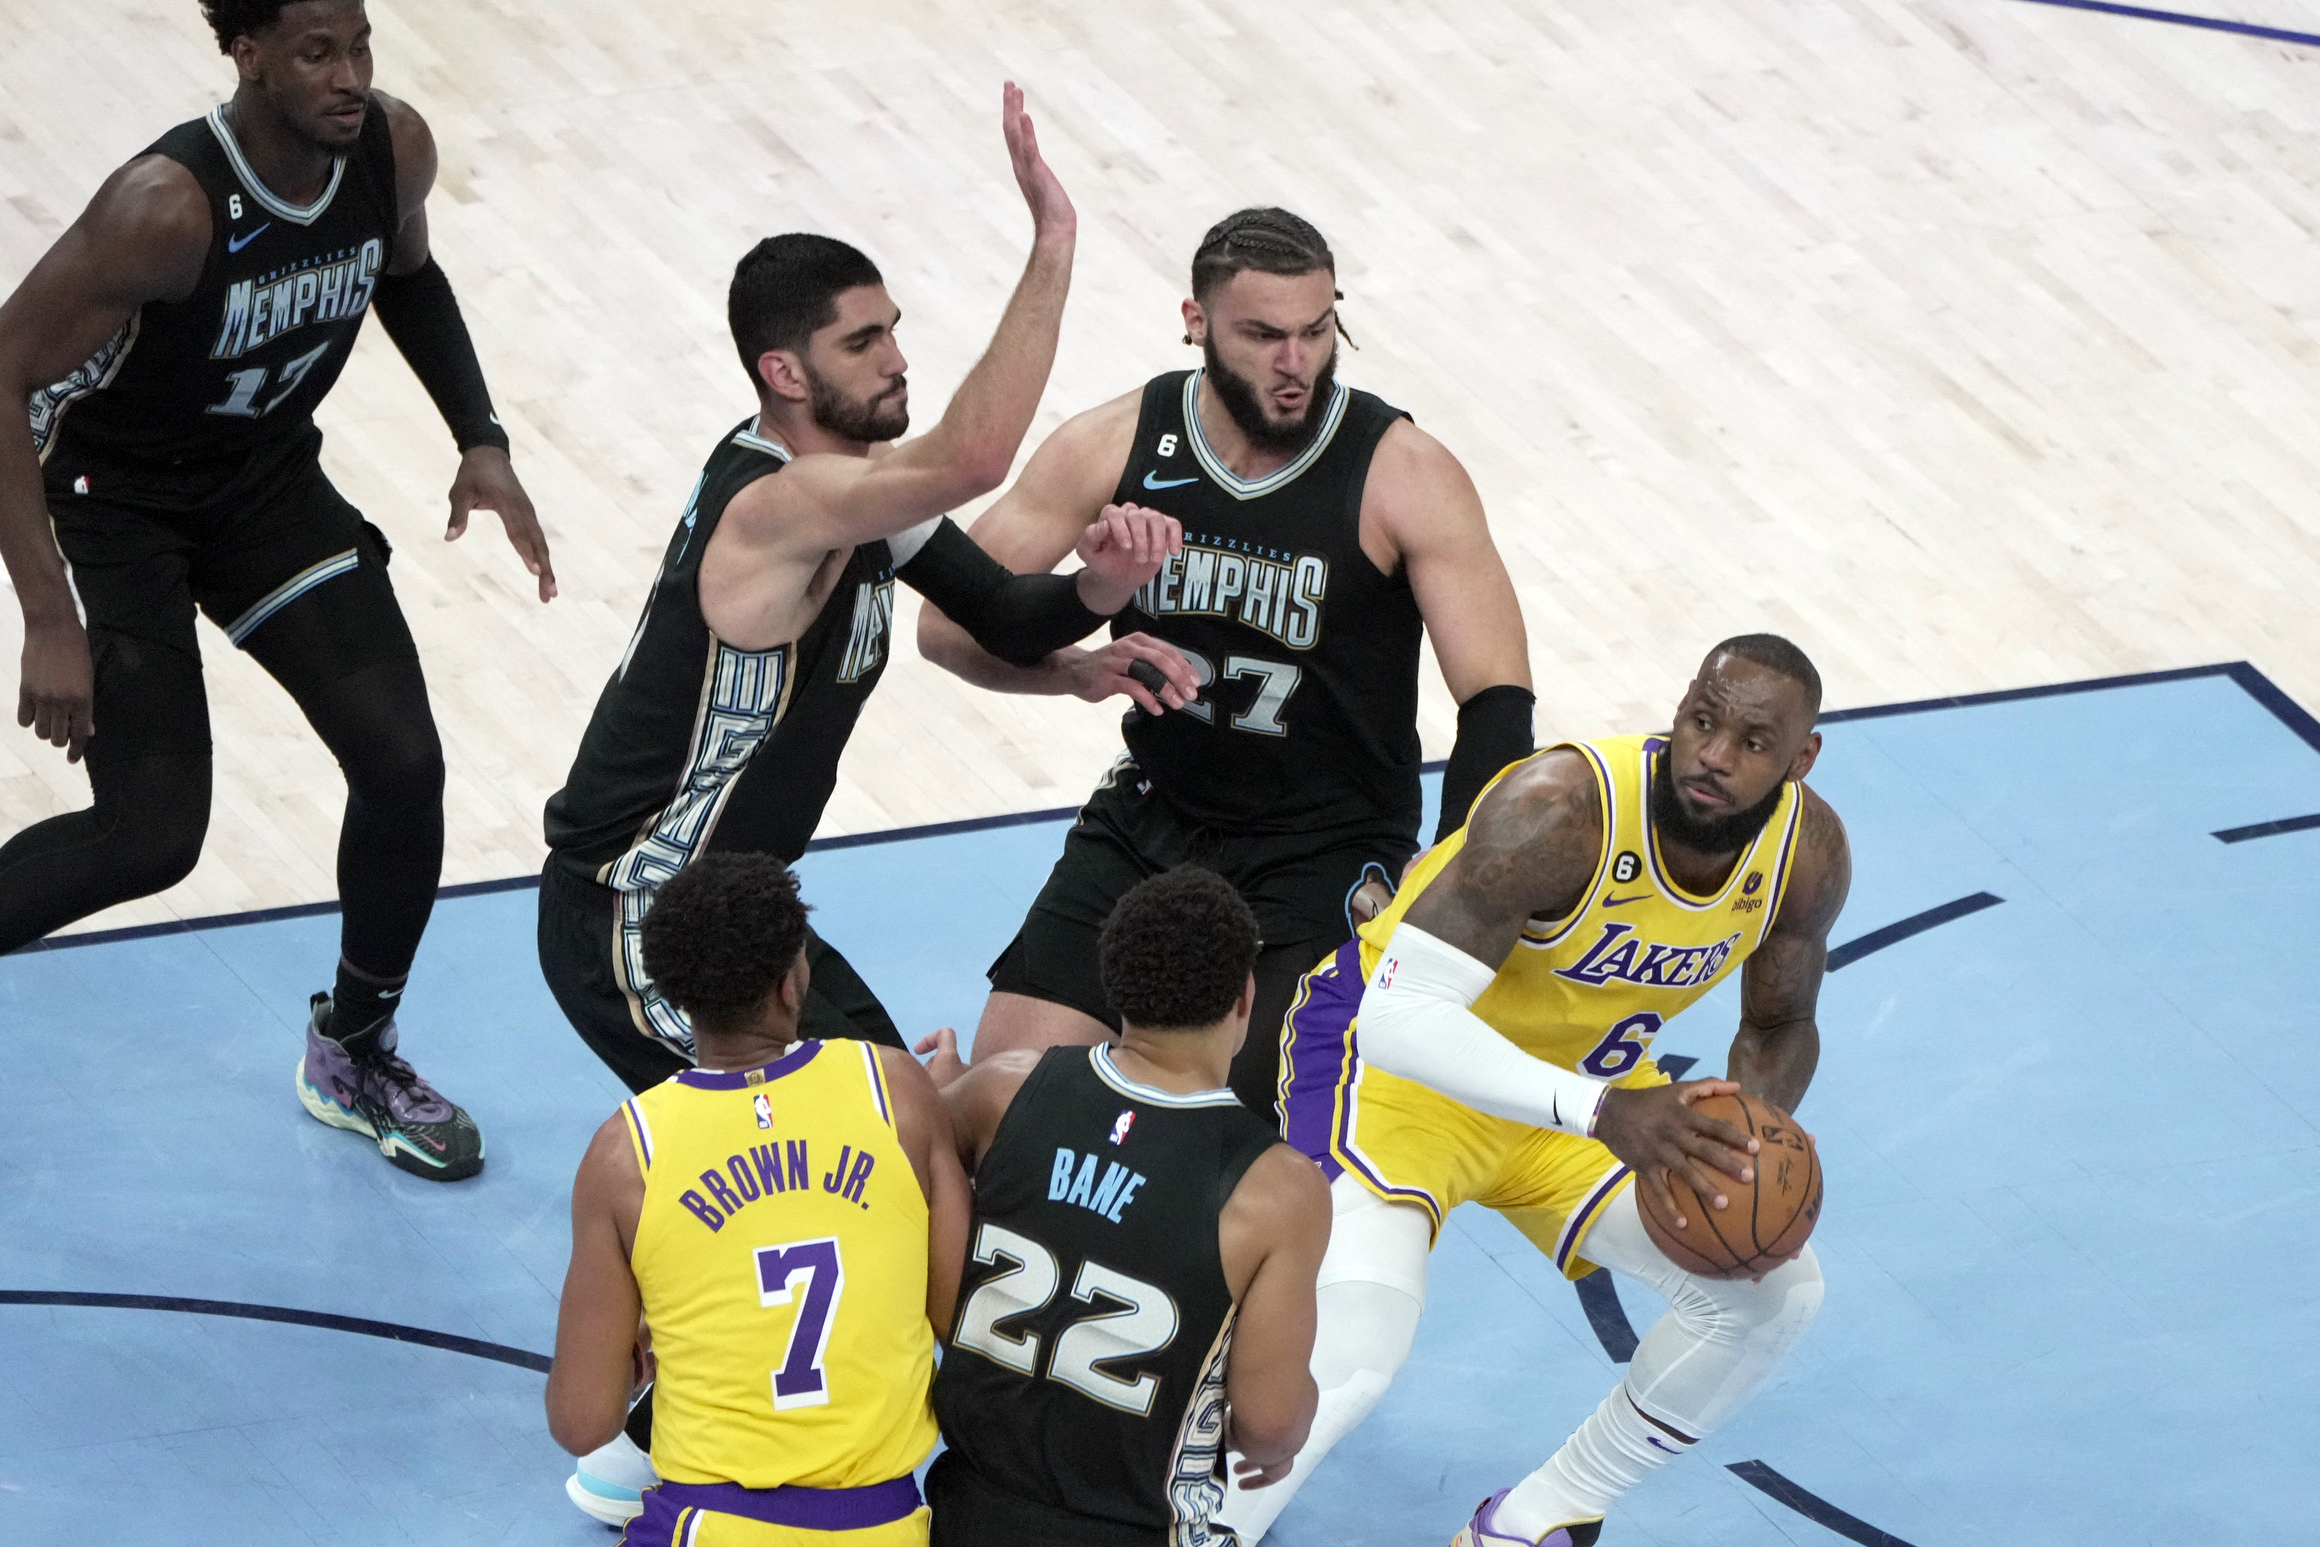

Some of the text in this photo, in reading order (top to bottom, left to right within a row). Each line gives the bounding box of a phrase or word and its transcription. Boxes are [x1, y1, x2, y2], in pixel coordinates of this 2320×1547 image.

[228, 193, 243, 220] 6
[209, 237, 383, 359] MEMPHIS
[258, 247, 357, 285] GRIZZLIES
[205, 339, 332, 419] 17
[1156, 434, 1178, 458] 6
[1184, 531, 1292, 562] RIZZLIES
[1615, 855, 1635, 881] 6
[1731, 897, 1763, 913] bibigo
[1551, 921, 1743, 988] LAKERS
[1576, 1010, 1665, 1083] 6
[678, 1139, 875, 1234] BROWN JR.
[1048, 1147, 1147, 1225] BANE
[752, 1235, 845, 1412] 7
[951, 1222, 1183, 1418] 22
